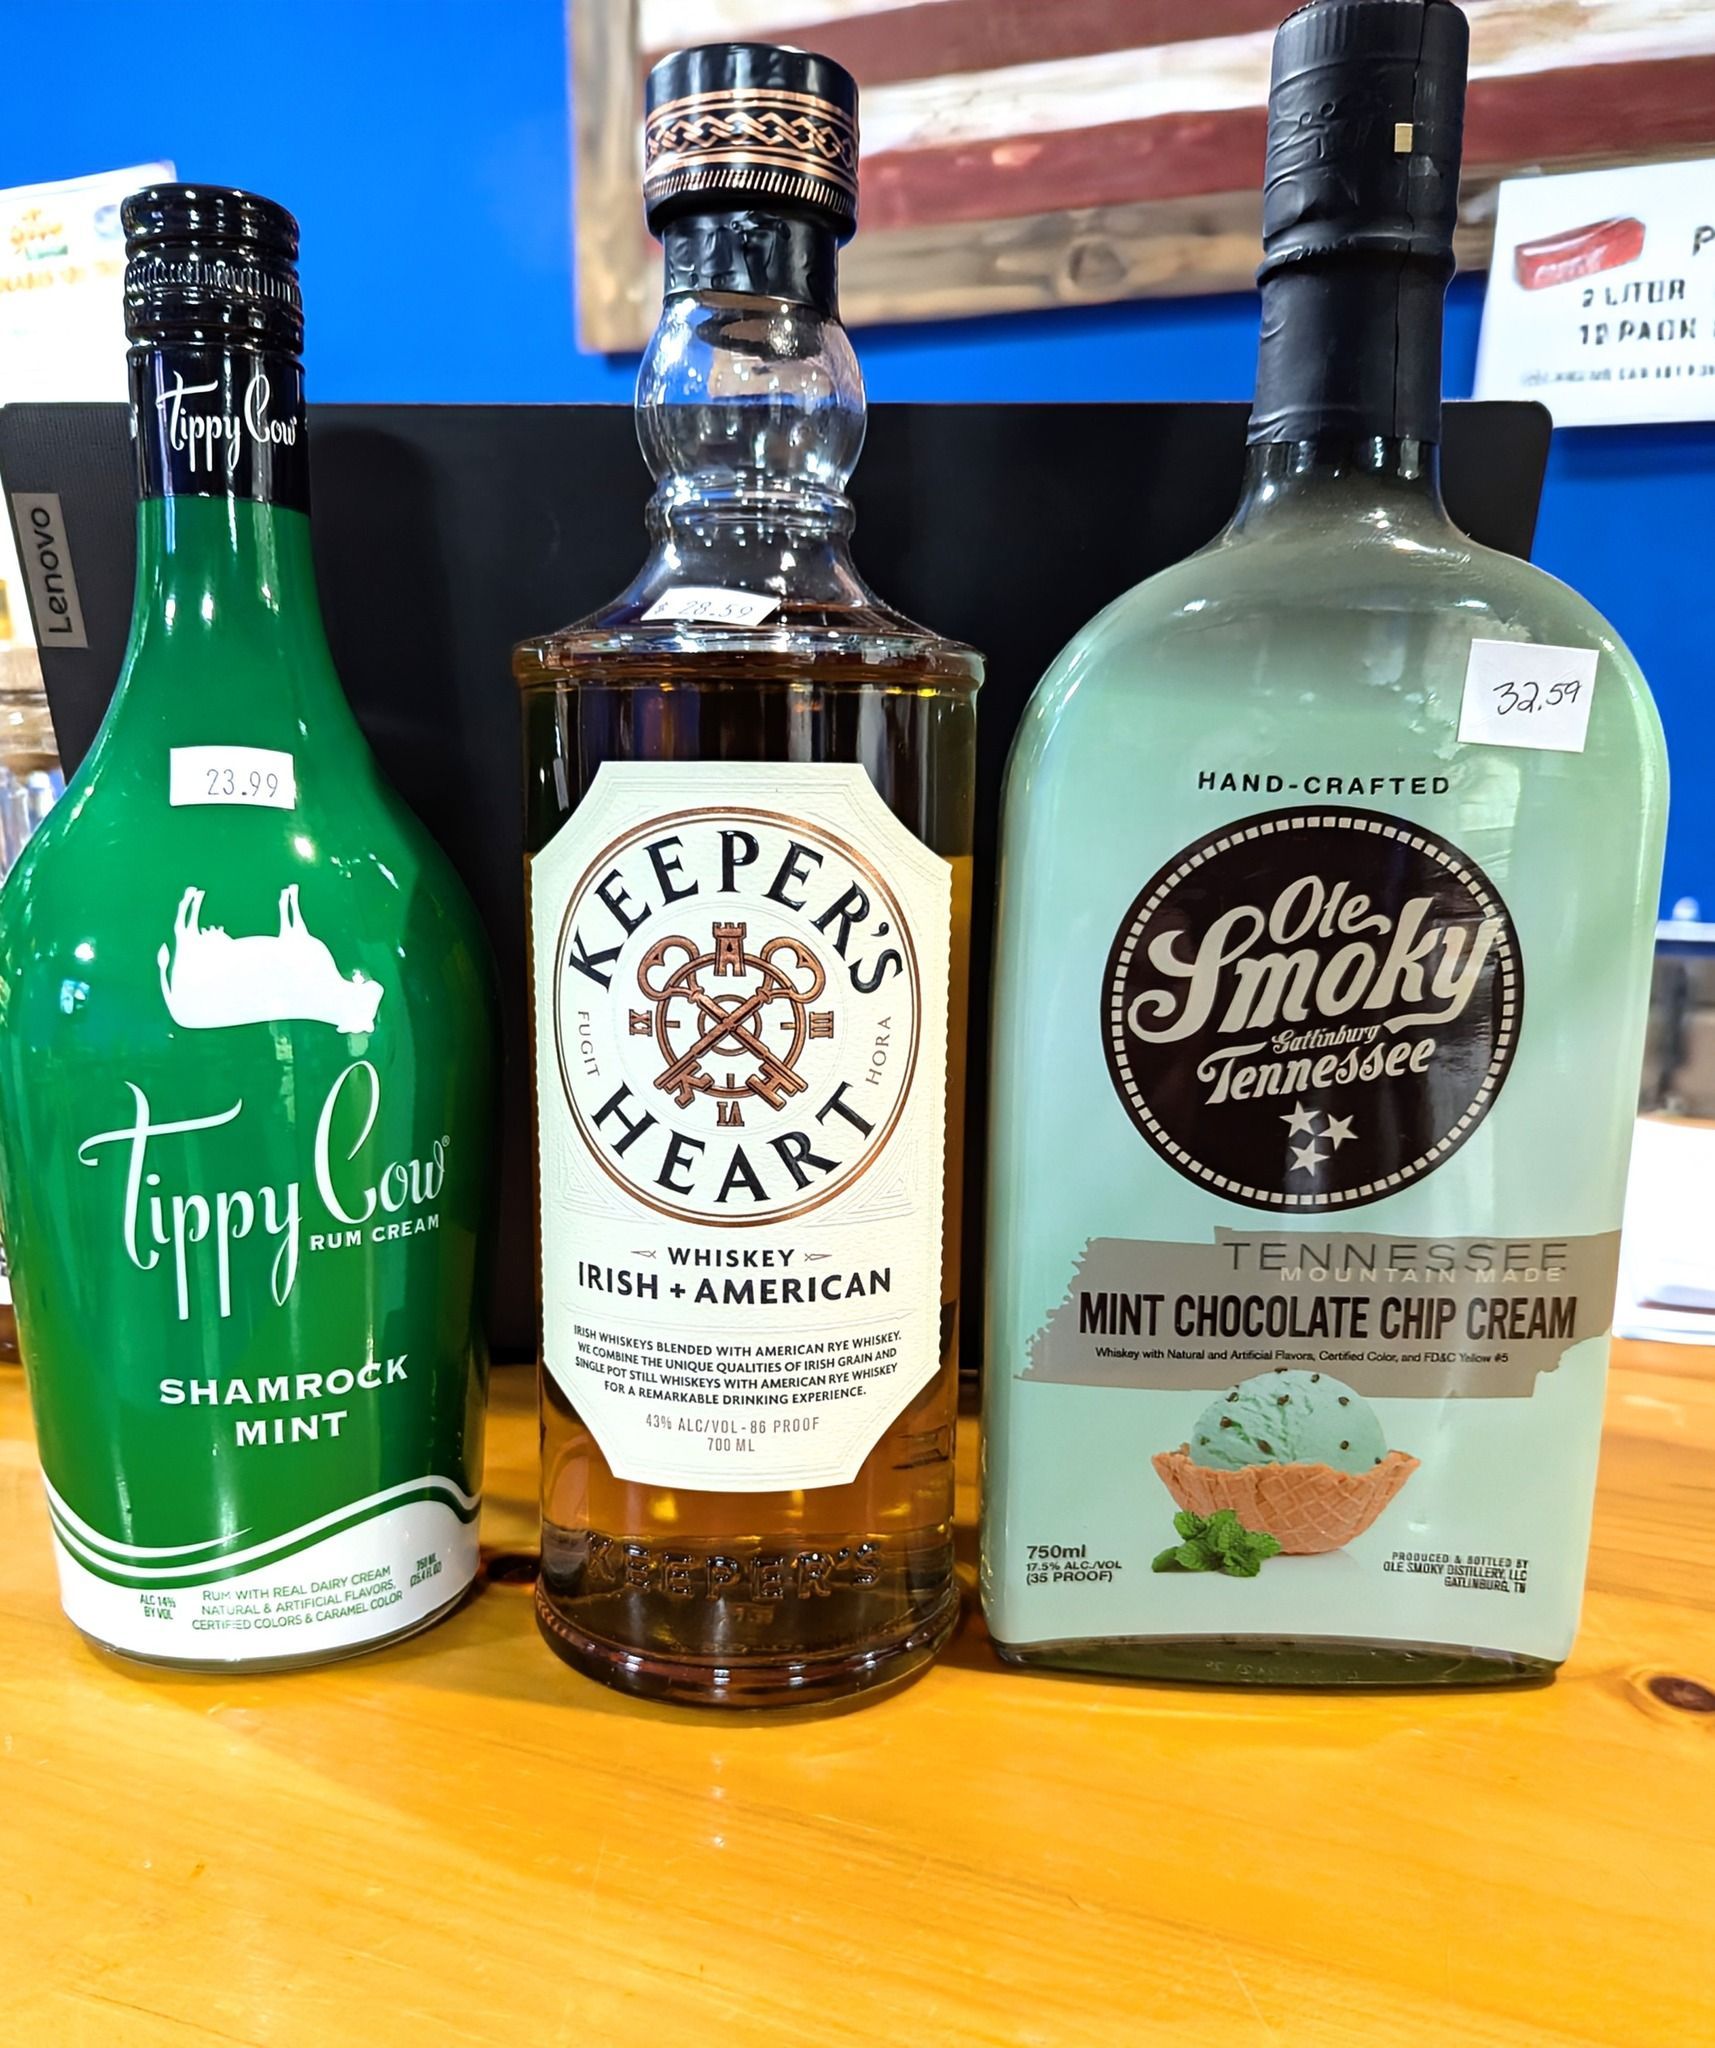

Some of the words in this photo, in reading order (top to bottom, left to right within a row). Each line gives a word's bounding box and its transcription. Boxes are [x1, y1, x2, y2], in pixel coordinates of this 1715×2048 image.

[156, 370, 241, 473] Tippy
[31, 507, 72, 632] Lenovo
[1493, 680, 1582, 715] 32.59
[207, 769, 278, 797] 23.99
[1198, 772, 1450, 795] HAND-CRAFTED
[569, 830, 904, 994] KEEPER'S
[1268, 875, 1392, 945] Ole
[1127, 897, 1504, 1043] Smoky
[578, 1011, 600, 1076] FUGIT
[866, 1016, 891, 1085] HORA
[1197, 1038, 1436, 1105] Tennessee
[590, 1080, 877, 1203] HEART
[78, 1081, 302, 1321] Tippy
[310, 1230, 361, 1251] RUM
[372, 1214, 439, 1242] CREAM
[667, 1247, 794, 1267] WHISKEY
[1222, 1242, 1568, 1272] TENNESSEE
[578, 1261, 658, 1299] IRISH
[670, 1283, 686, 1298] +
[694, 1267, 891, 1304] AMERICAN
[1281, 1267, 1455, 1283] MOUNTAIN
[1474, 1267, 1562, 1283] MADE
[1080, 1291, 1164, 1336] MINT
[1174, 1295, 1370, 1339] CHOCOLATE
[1380, 1296, 1456, 1340] CHIP
[1466, 1296, 1577, 1340] CREAM
[574, 1324, 596, 1340] IRISH
[599, 1332, 653, 1351] WHISKEYS
[657, 1342, 712, 1355] BLENDED
[716, 1346, 751, 1356] WITH
[756, 1343, 824, 1356] AMERICAN
[828, 1340, 849, 1352] RYE
[852, 1330, 901, 1348] WHISKEY.
[578, 1341, 591, 1354] WE
[592, 1345, 639, 1364] COMBINE
[641, 1356, 662, 1368] THE
[665, 1359, 713, 1373] UNIQUE
[716, 1362, 781, 1374] QUALITIES
[784, 1361, 801, 1372] OF
[804, 1358, 835, 1370] IRISH
[838, 1352, 873, 1367] GRAIN
[875, 1347, 897, 1361] AND
[1096, 1347, 1139, 1360] Whiskey
[1142, 1350, 1164, 1359] with
[1167, 1350, 1204, 1359] Natural
[1207, 1350, 1227, 1359] and
[1230, 1350, 1272, 1360] Artificial
[1275, 1351, 1315, 1362] Flavors,
[1319, 1351, 1364, 1362] Certified
[1367, 1352, 1399, 1363] Color,
[1401, 1352, 1420, 1362] and
[1424, 1353, 1456, 1363] FD&C
[1459, 1353, 1491, 1363] Yellow
[1494, 1353, 1509, 1363] #5
[160, 1354, 408, 1405] SHAMROCK
[575, 1356, 605, 1373] SINGLE
[607, 1365, 627, 1378] POT
[630, 1370, 658, 1383] STILL
[660, 1374, 721, 1389] WHISKEYS
[724, 1379, 757, 1389] WITH
[761, 1375, 826, 1389] AMERICAN
[829, 1372, 850, 1385] RYE
[852, 1362, 898, 1381] WHISKEY
[604, 1380, 625, 1394] FOR
[628, 1386, 636, 1396] A
[639, 1387, 719, 1405] REMARKABLE
[723, 1395, 788, 1405] DRINKING
[792, 1386, 866, 1404] EXPERIENCE.
[235, 1410, 347, 1446] MINT
[646, 1414, 672, 1430] 43%
[773, 1416, 820, 1433] PROOF
[707, 1437, 730, 1451] 700
[736, 1438, 755, 1452] ML
[587, 1530, 882, 1600] KEEPER'S
[1026, 1544, 1086, 1559] 750ml
[1026, 1562, 1060, 1571] 17.5%
[1392, 1552, 1449, 1563] PRODUCED
[1467, 1556, 1512, 1568] BOTTLED
[1516, 1559, 1529, 1568] BY
[203, 1590, 231, 1601] RUM
[235, 1588, 269, 1600] WITH
[273, 1585, 307, 1598] REAL
[311, 1577, 348, 1593] DAIRY
[351, 1565, 391, 1585] CREAM
[1026, 1572, 1048, 1585] (35
[1053, 1570, 1113, 1583] PROOF)
[1384, 1561, 1404, 1572] OLE
[1406, 1562, 1445, 1575] SMOKY
[1509, 1570, 1527, 1581] LLC
[140, 1594, 155, 1605] ALC
[192, 1620, 251, 1630] CERTIFIED
[254, 1614, 302, 1629] COLORS
[305, 1613, 313, 1624] &
[316, 1603, 368, 1621] CARAMEL
[370, 1590, 403, 1610] COLOR
[202, 1604, 261, 1615] NATURAL
[264, 1603, 271, 1614] &
[276, 1595, 342, 1612] ARTIFICIAL
[345, 1579, 396, 1601] FLAVORS,
